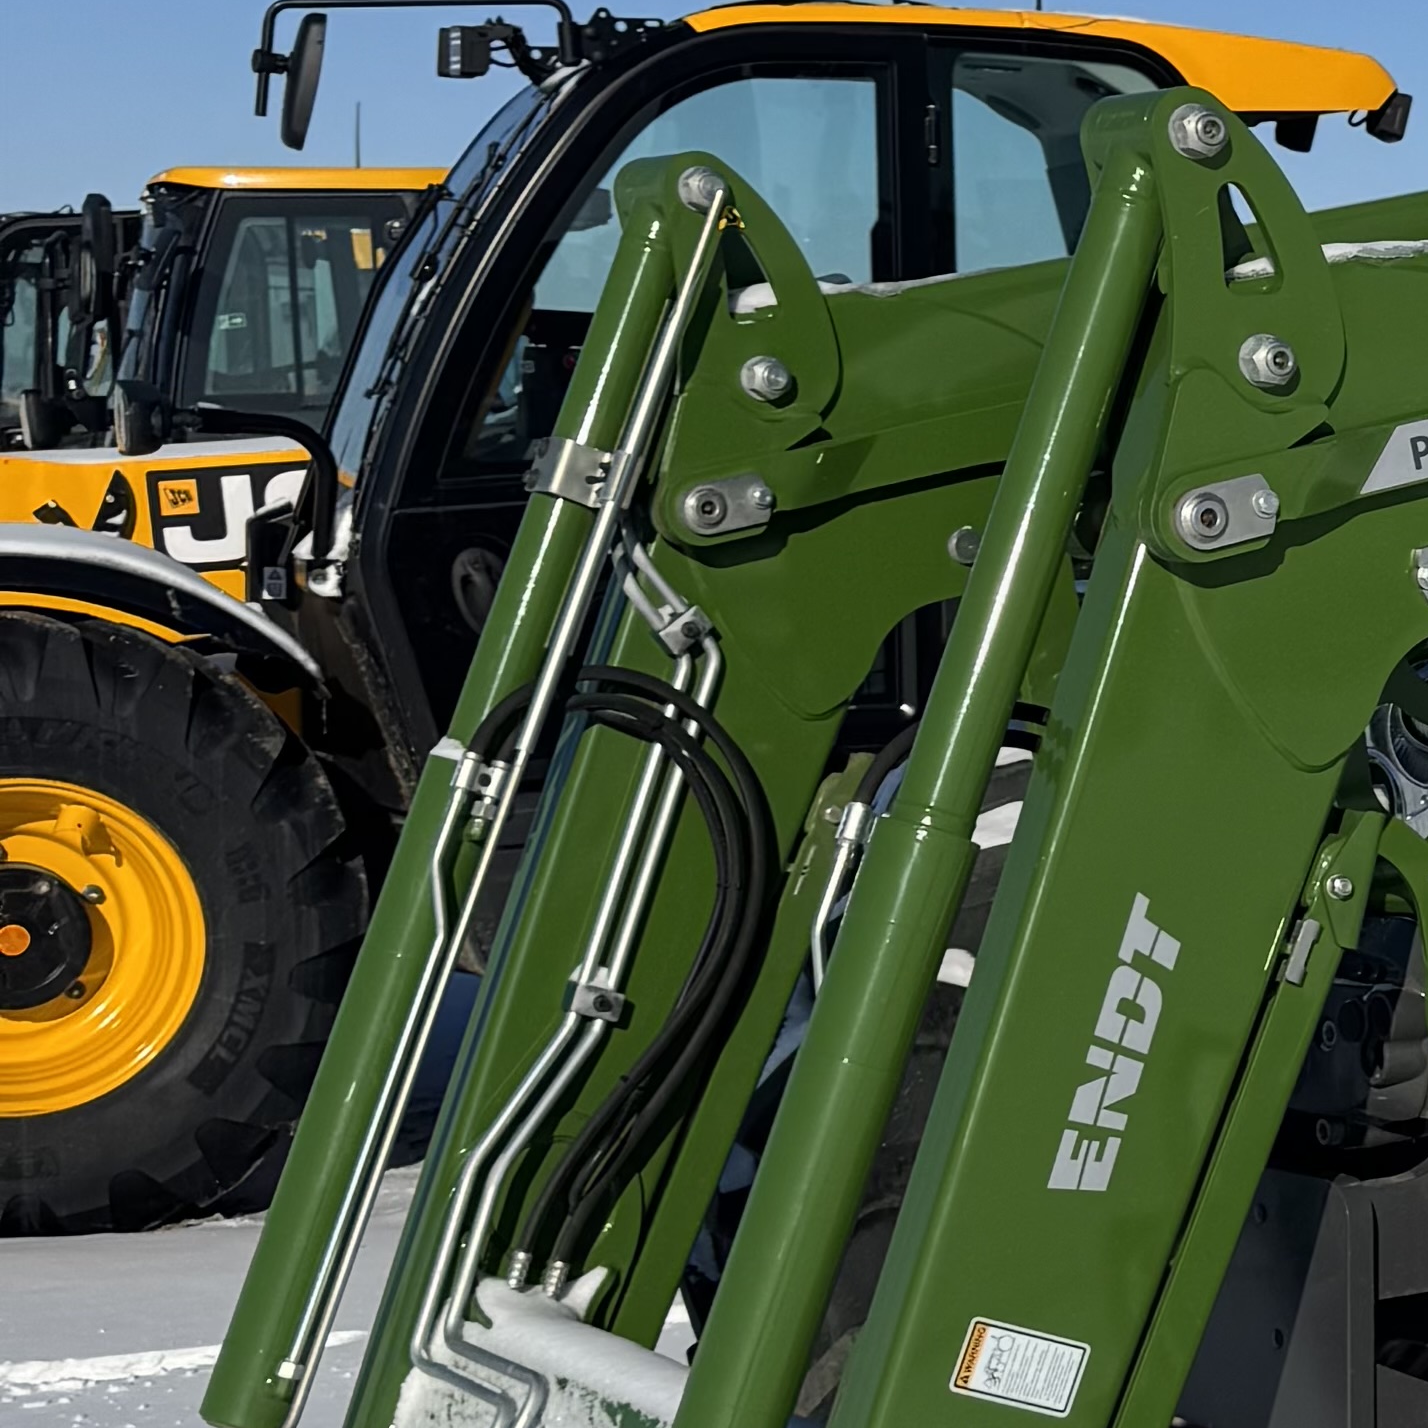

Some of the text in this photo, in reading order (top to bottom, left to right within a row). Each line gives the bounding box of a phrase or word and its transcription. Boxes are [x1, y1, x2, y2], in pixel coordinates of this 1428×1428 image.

[209, 969, 270, 1065] XMCL
[1047, 892, 1181, 1191] ENDT
[965, 1326, 987, 1372] WARNING
